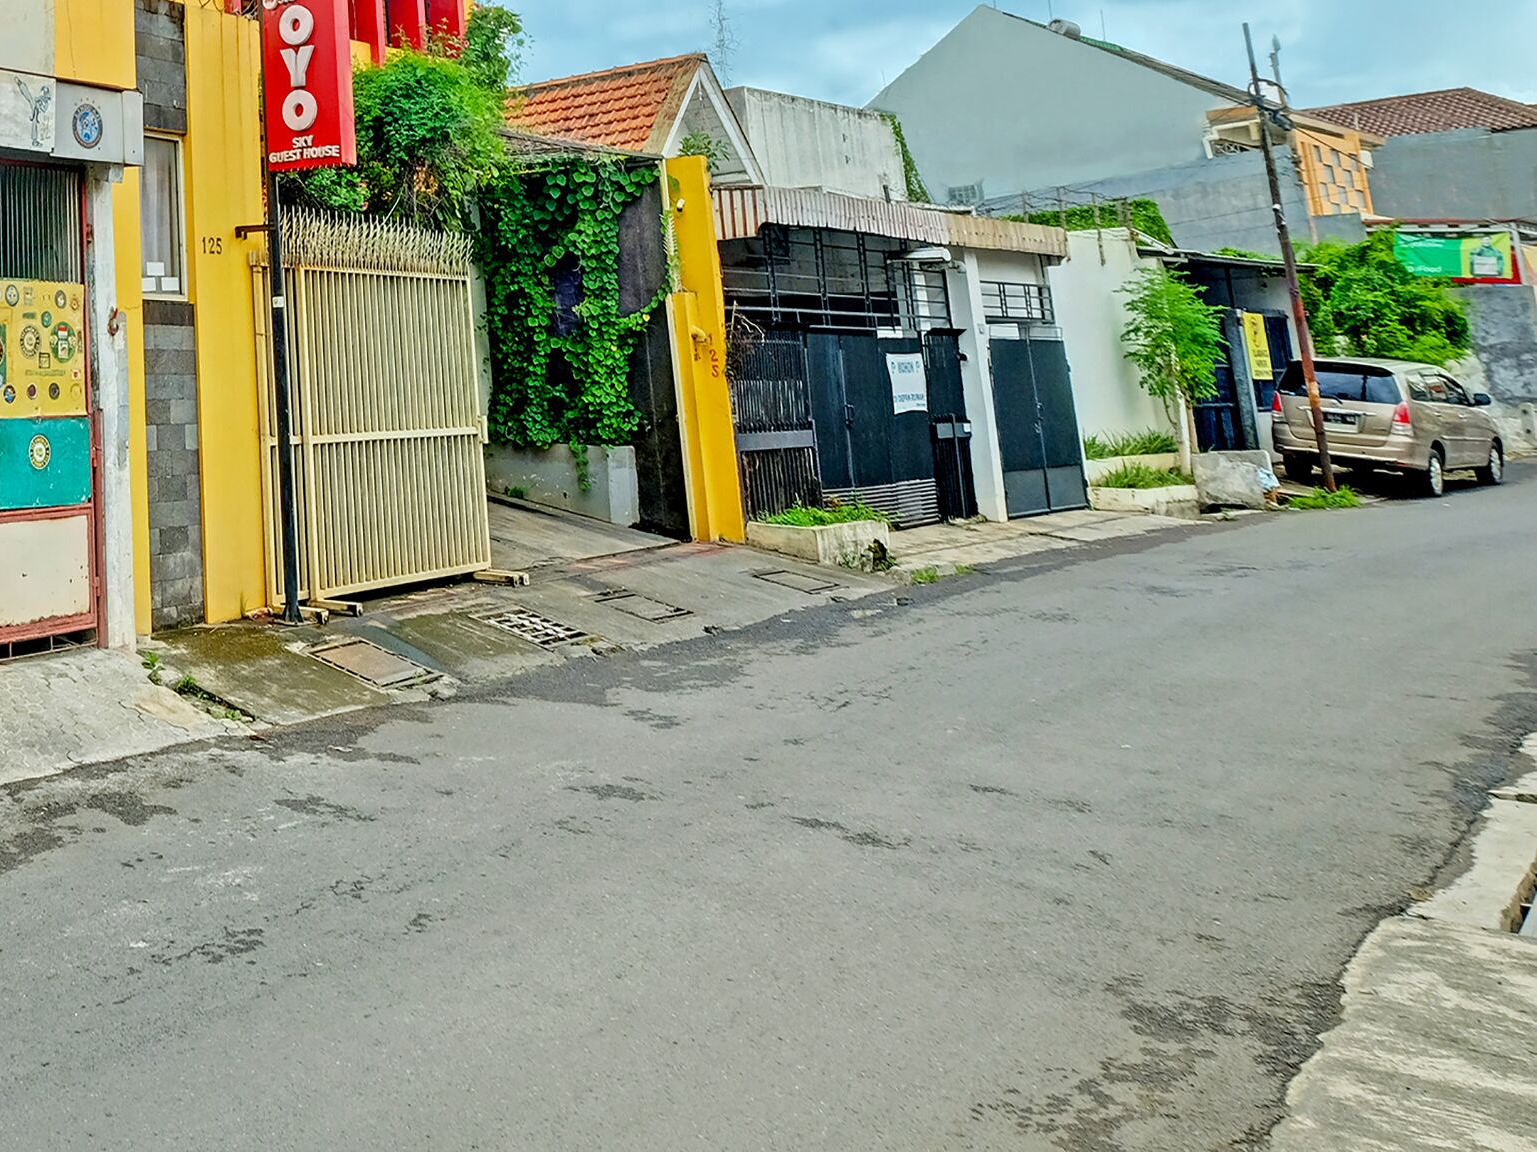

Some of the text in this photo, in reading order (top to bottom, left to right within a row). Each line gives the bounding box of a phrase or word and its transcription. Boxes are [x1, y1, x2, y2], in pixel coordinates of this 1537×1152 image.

[278, 4, 318, 132] OYO
[292, 134, 314, 149] SKY
[268, 144, 340, 164] GUEST HOUSE
[202, 236, 223, 255] 125
